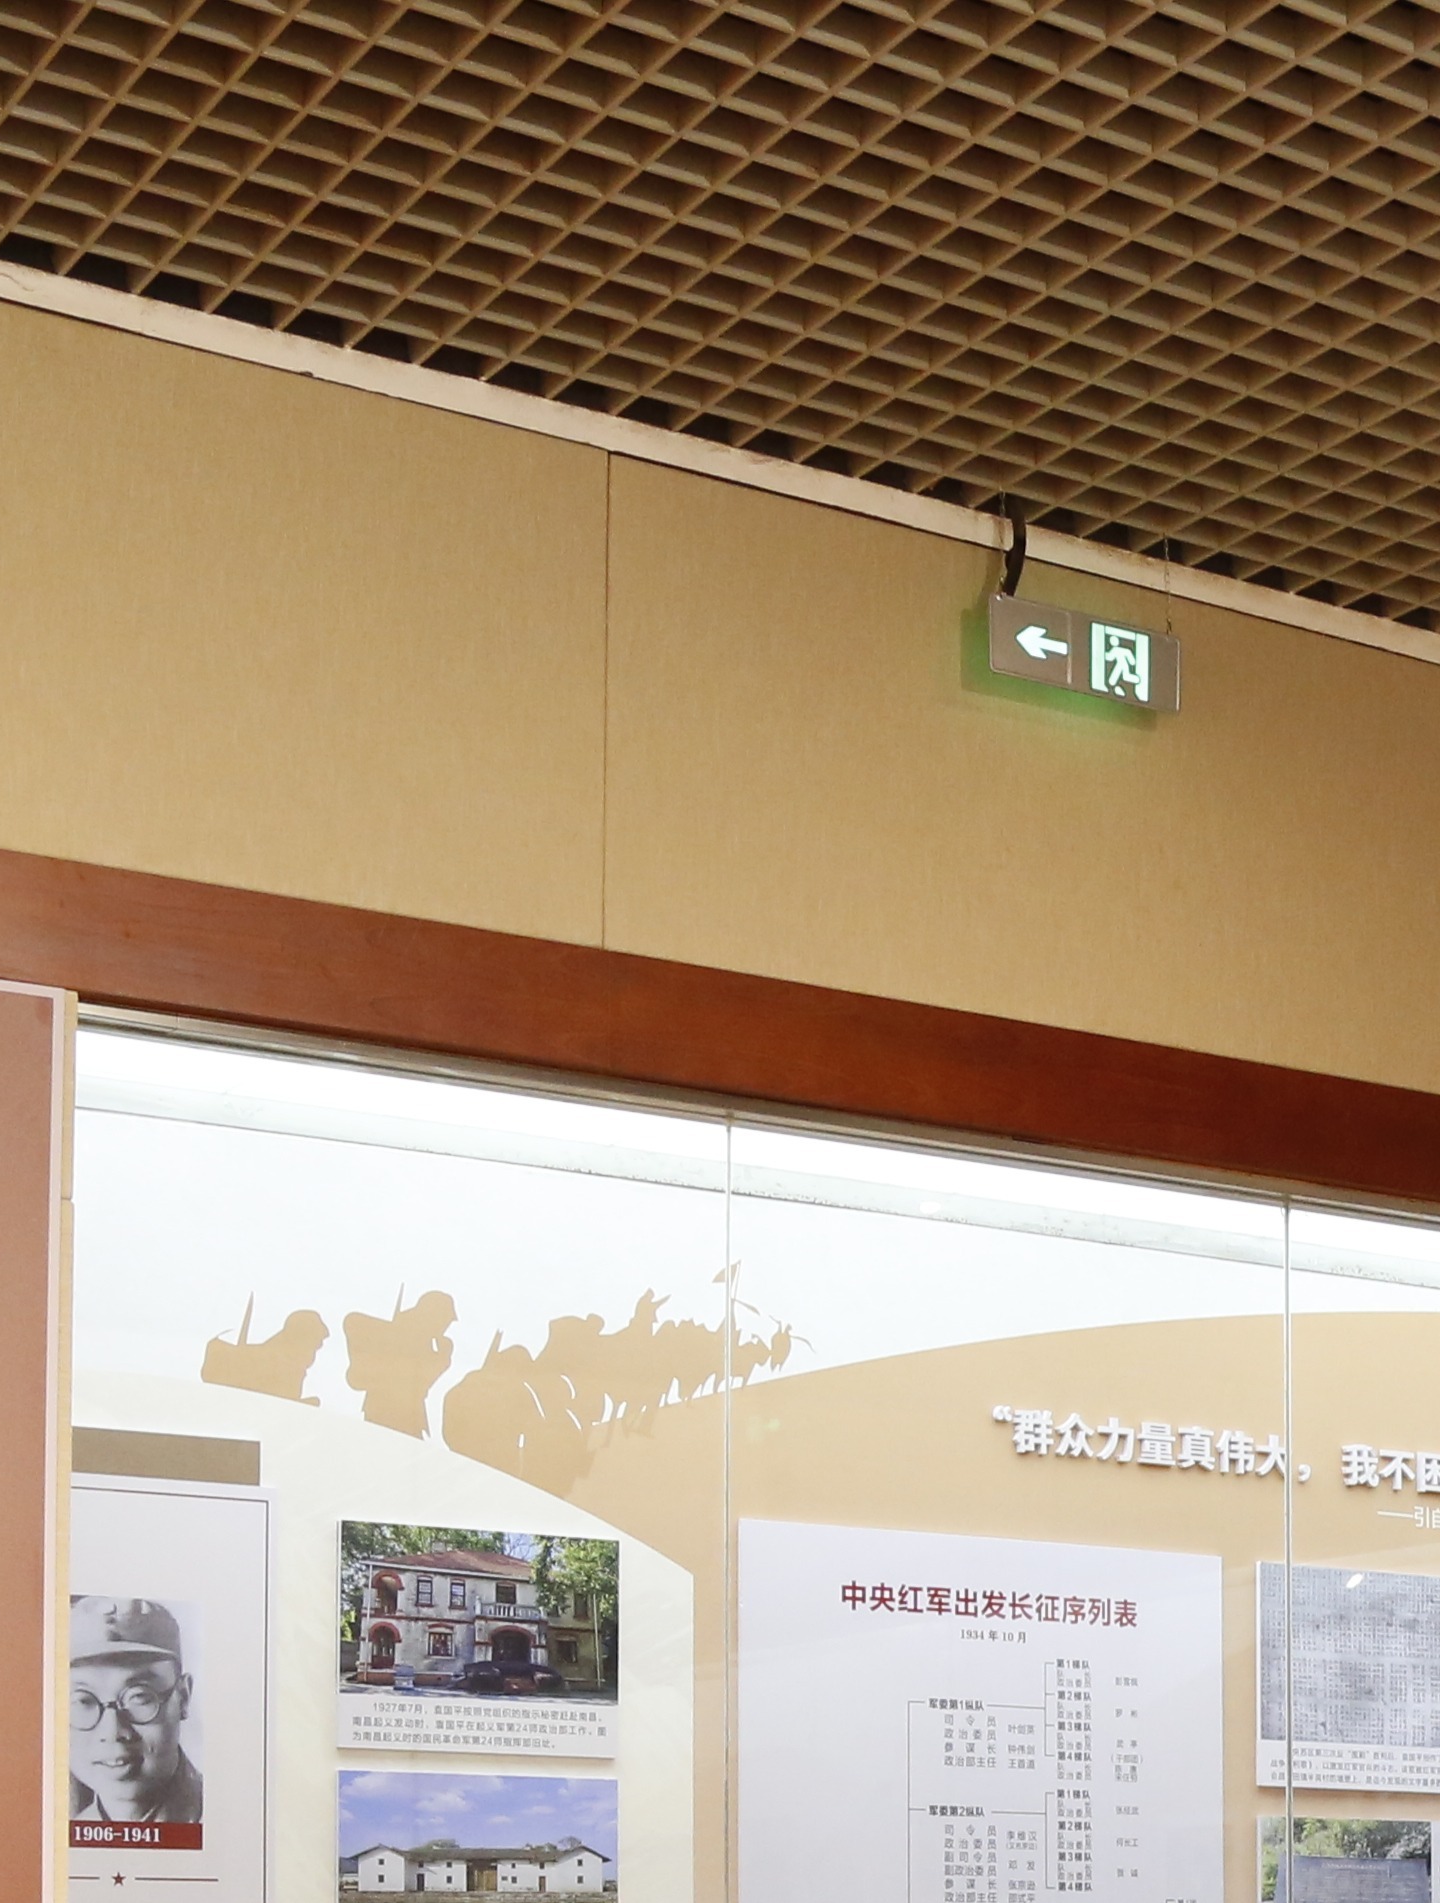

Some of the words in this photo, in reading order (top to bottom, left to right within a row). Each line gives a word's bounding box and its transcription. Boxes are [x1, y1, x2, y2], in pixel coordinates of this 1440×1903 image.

[841, 1580, 1138, 1628] 中央红军出发长征序列表
[73, 1825, 161, 1844] 1906-1941
